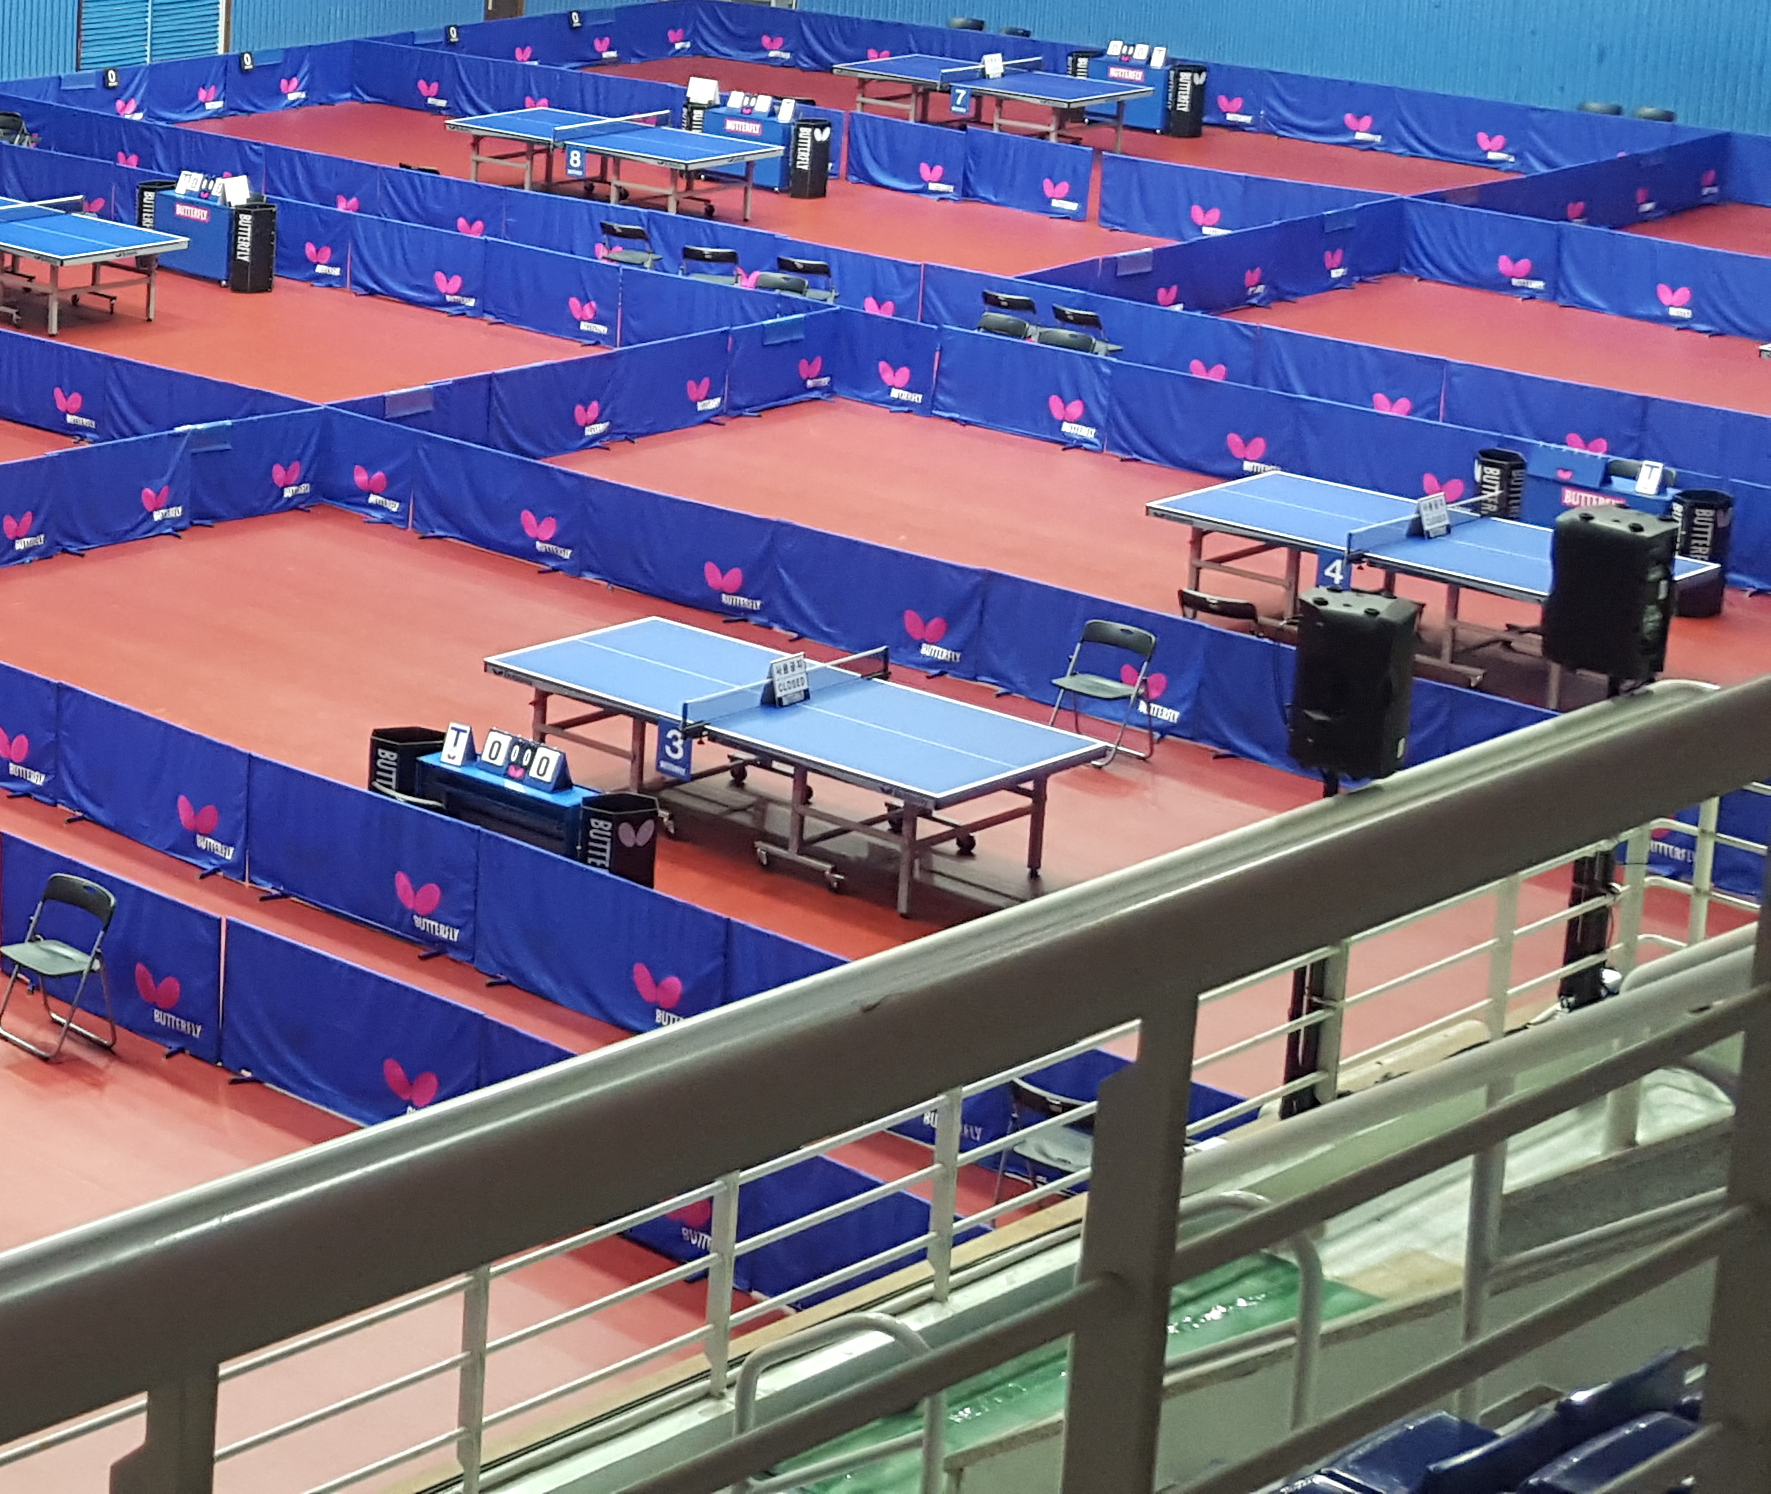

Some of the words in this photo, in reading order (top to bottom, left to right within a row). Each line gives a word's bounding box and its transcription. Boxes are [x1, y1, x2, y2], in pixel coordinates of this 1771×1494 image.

[244, 53, 251, 65] 0
[108, 69, 116, 82] 0
[955, 89, 967, 106] 7
[1177, 72, 1192, 112] BUTTERFLY
[725, 119, 760, 134] BUTTERFLY
[569, 150, 580, 168] 8
[796, 127, 812, 170] BUTTERFLY
[175, 203, 208, 221] BUTTERFLY
[236, 213, 252, 263] BUTTERFLY
[1061, 422, 1096, 438] BUTTERFLY
[1644, 463, 1660, 481] T
[1324, 559, 1344, 584] 4
[722, 594, 762, 610] BUTTERFLY
[920, 643, 961, 662] BUTTERFLY
[778, 677, 805, 693] CLOSED
[451, 725, 468, 748] T
[665, 729, 684, 759] 3
[488, 739, 502, 761] 0
[536, 755, 550, 777] 0
[9, 762, 46, 786] BUTTERFLY
[196, 834, 234, 860] BUTTERFLY
[587, 817, 613, 873] BUTTE
[413, 915, 459, 942] BUTTERFLY
[154, 1009, 201, 1038] BUTTERFLY
